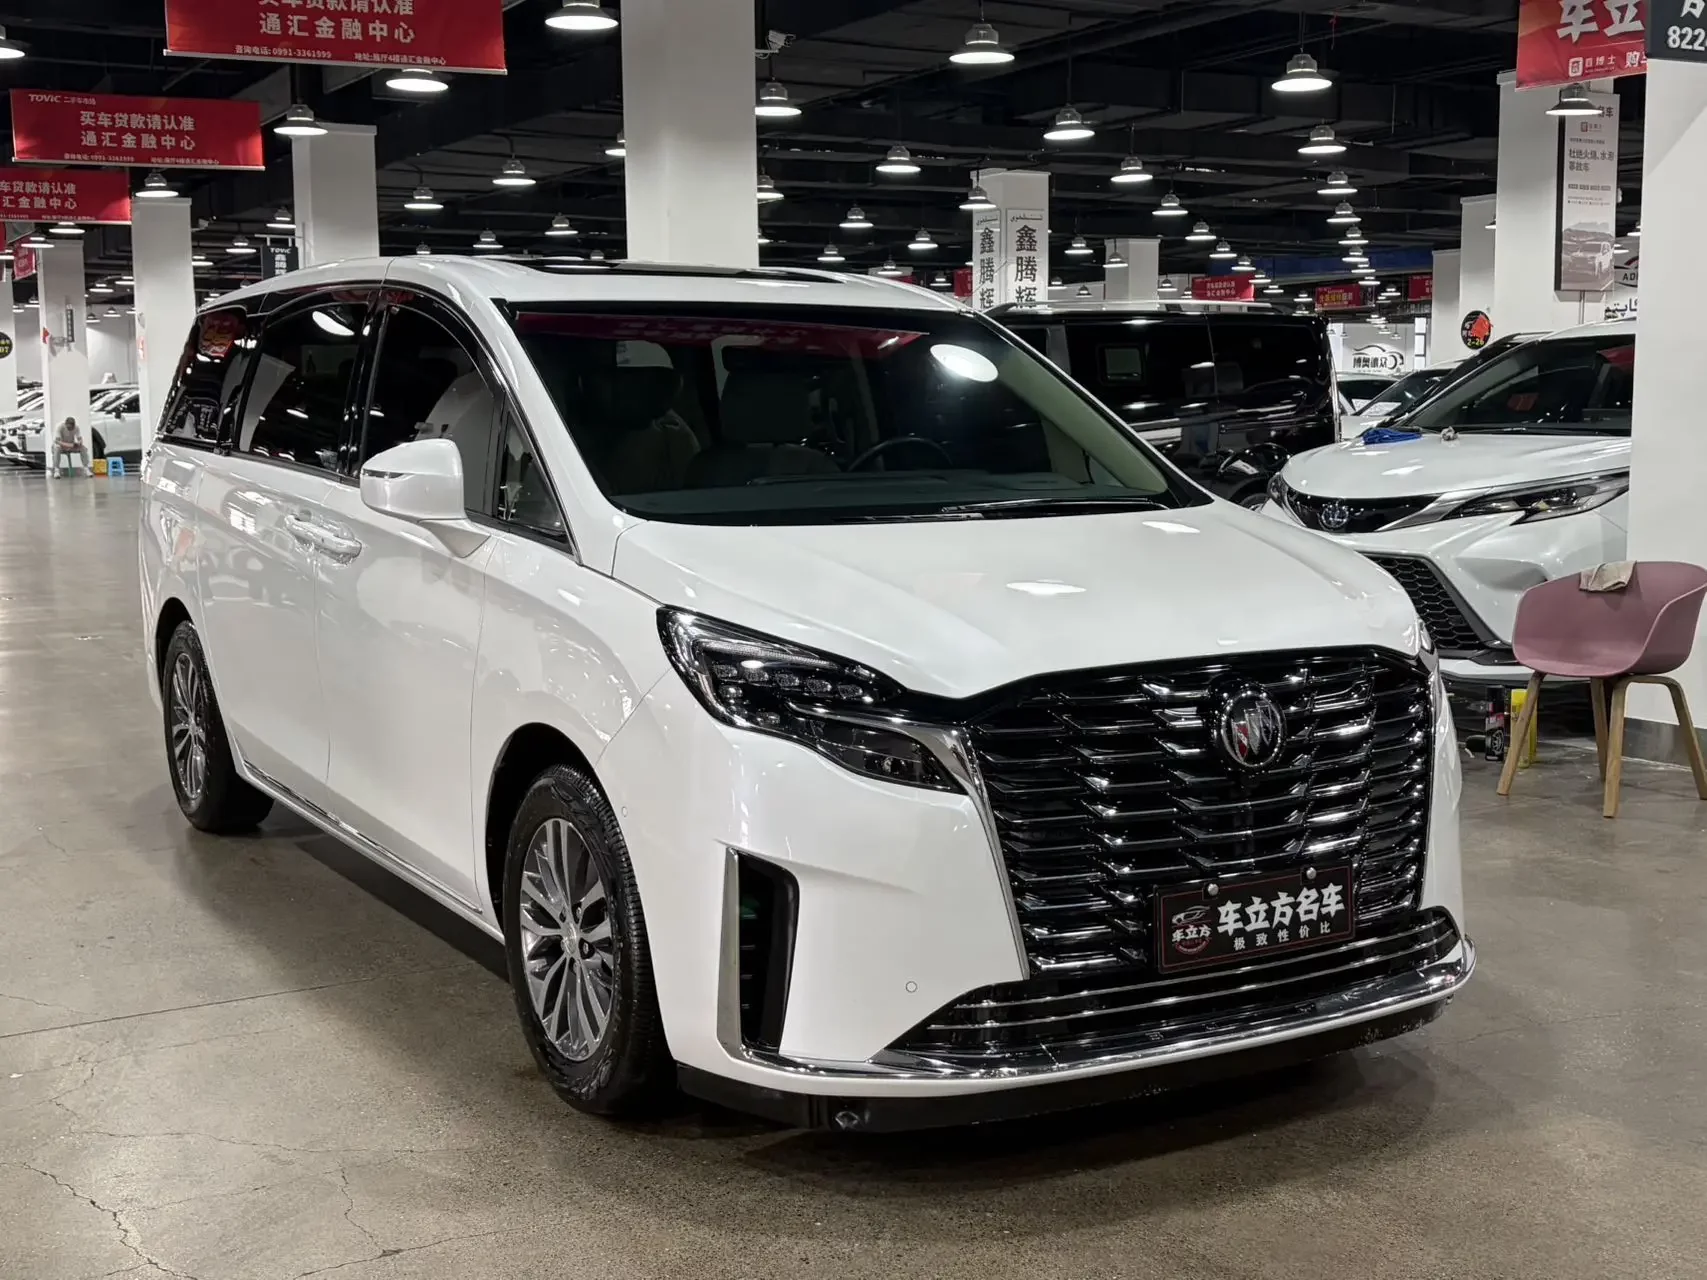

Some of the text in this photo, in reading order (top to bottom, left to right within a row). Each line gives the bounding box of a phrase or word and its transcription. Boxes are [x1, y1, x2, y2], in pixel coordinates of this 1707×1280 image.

[259, 11, 416, 44] 通汇金融中心
[1667, 25, 1707, 51] 822
[80, 110, 196, 132] 买车贷款请认准
[80, 130, 196, 151] 通汇金融中心
[2, 195, 78, 210] 汇金融中心
[1217, 882, 1346, 936] 车立方名车
[1171, 924, 1213, 943] 车立方
[1233, 920, 1331, 951] 极致性价比
